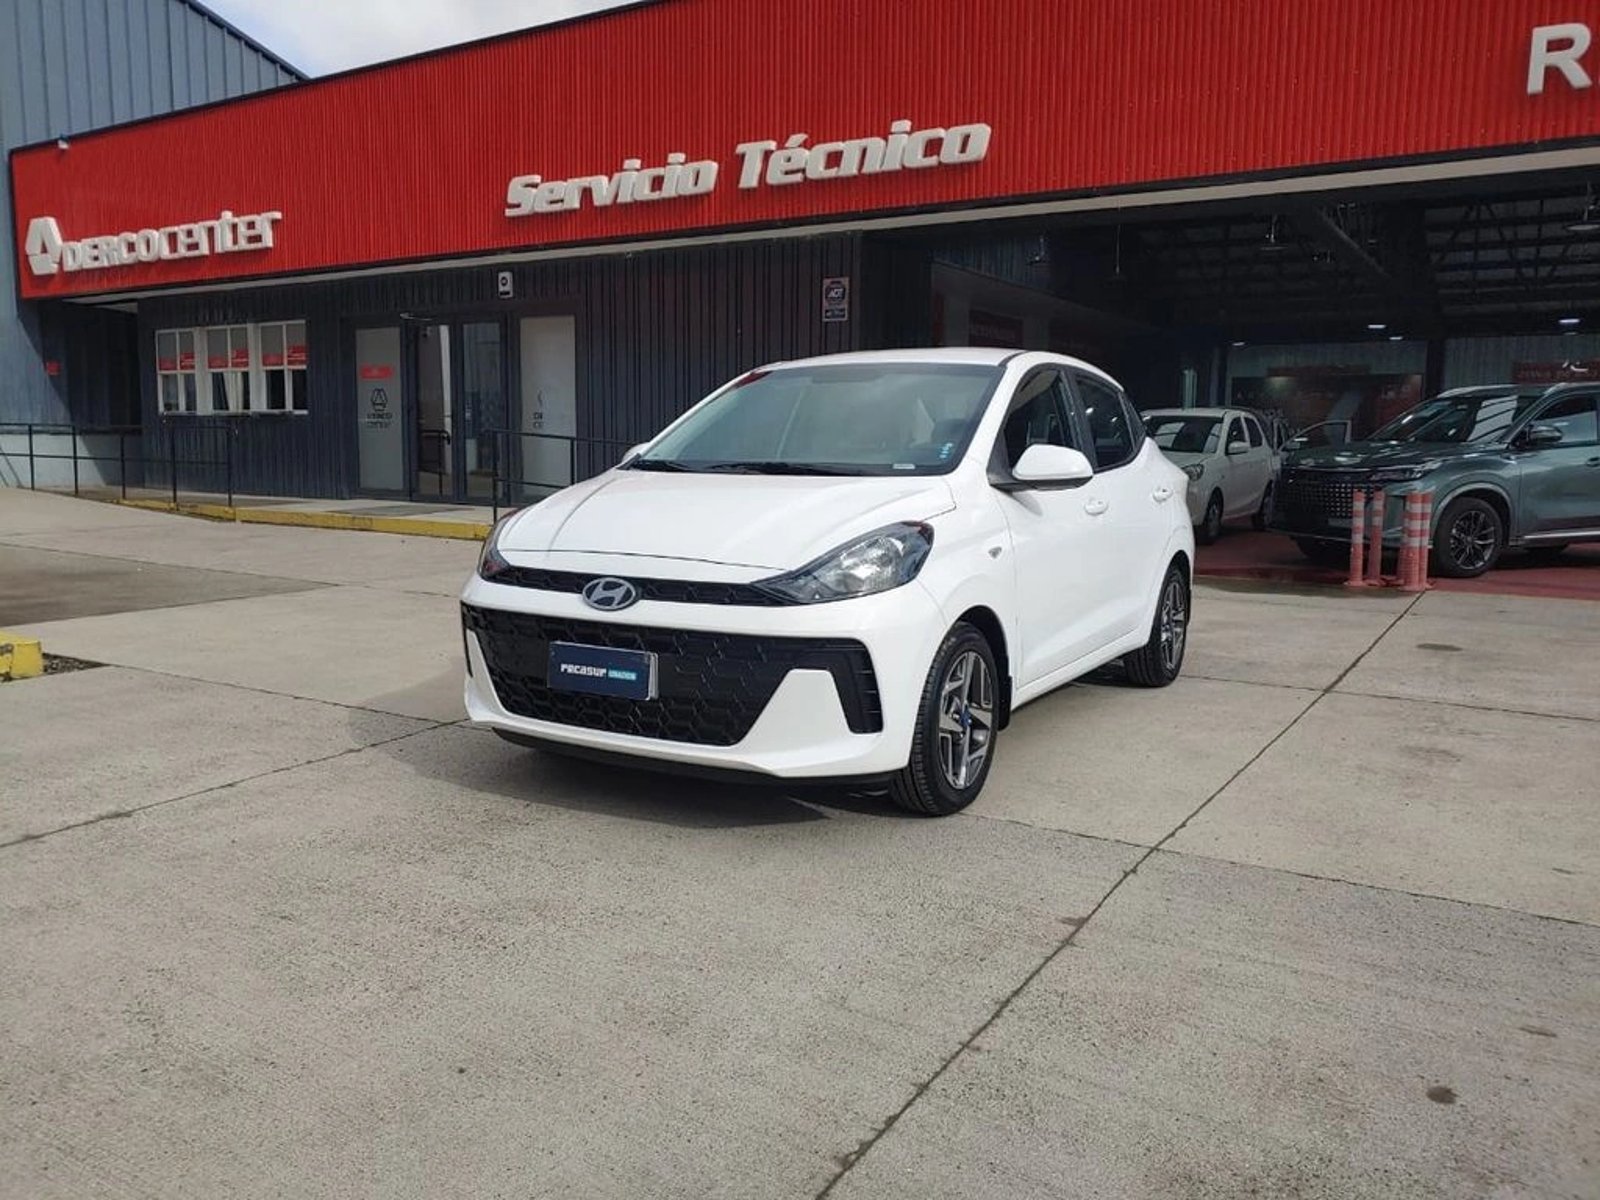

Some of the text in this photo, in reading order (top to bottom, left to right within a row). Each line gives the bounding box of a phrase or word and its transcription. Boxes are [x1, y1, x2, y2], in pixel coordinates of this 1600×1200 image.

[1526, 22, 1600, 95] R
[505, 119, 991, 217] Servicio Técnico
